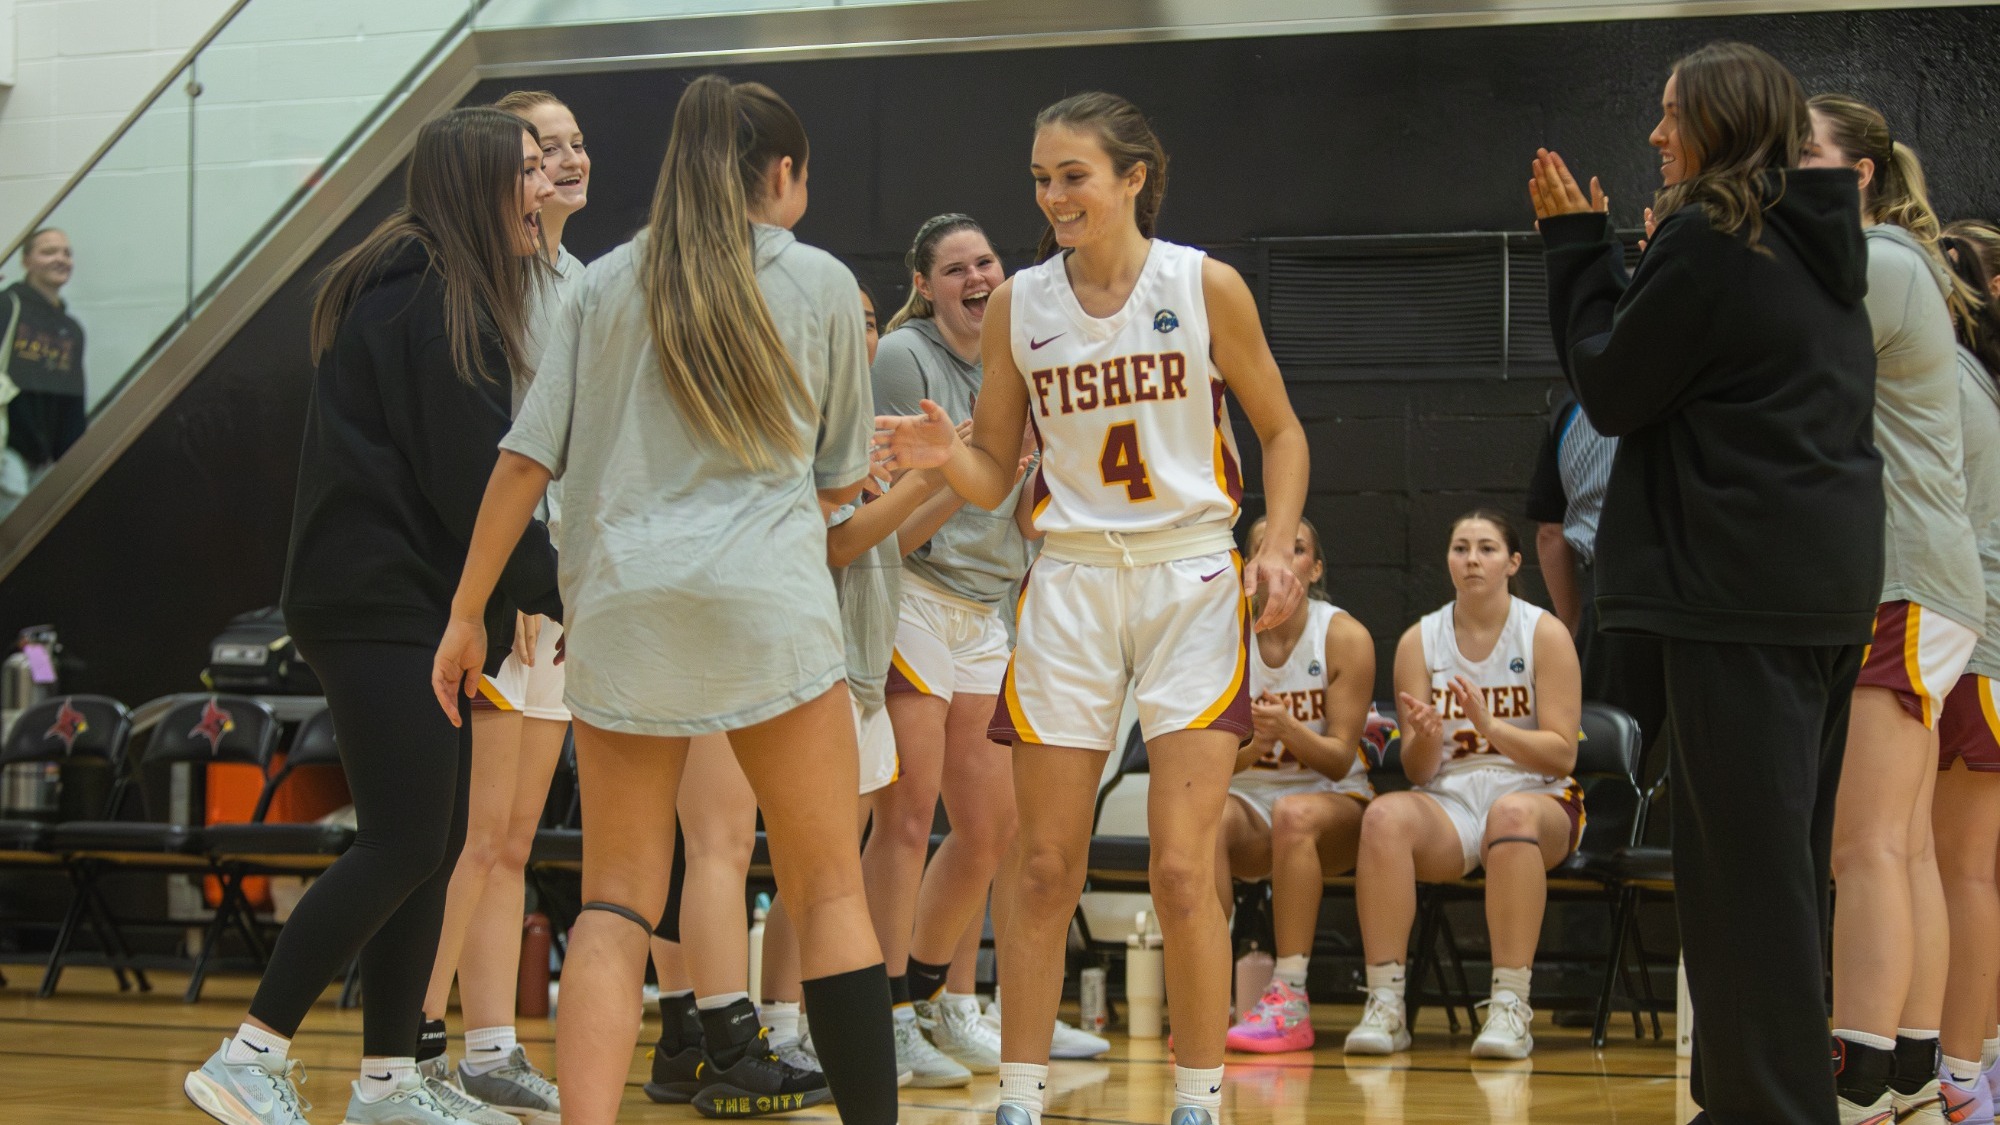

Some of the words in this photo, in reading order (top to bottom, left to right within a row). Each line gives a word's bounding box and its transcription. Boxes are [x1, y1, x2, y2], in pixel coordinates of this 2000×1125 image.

[1031, 352, 1187, 417] FISHER
[1098, 420, 1156, 503] 4
[1431, 686, 1531, 719] FISER
[713, 1097, 751, 1113] THE
[756, 1092, 804, 1112] CITY
